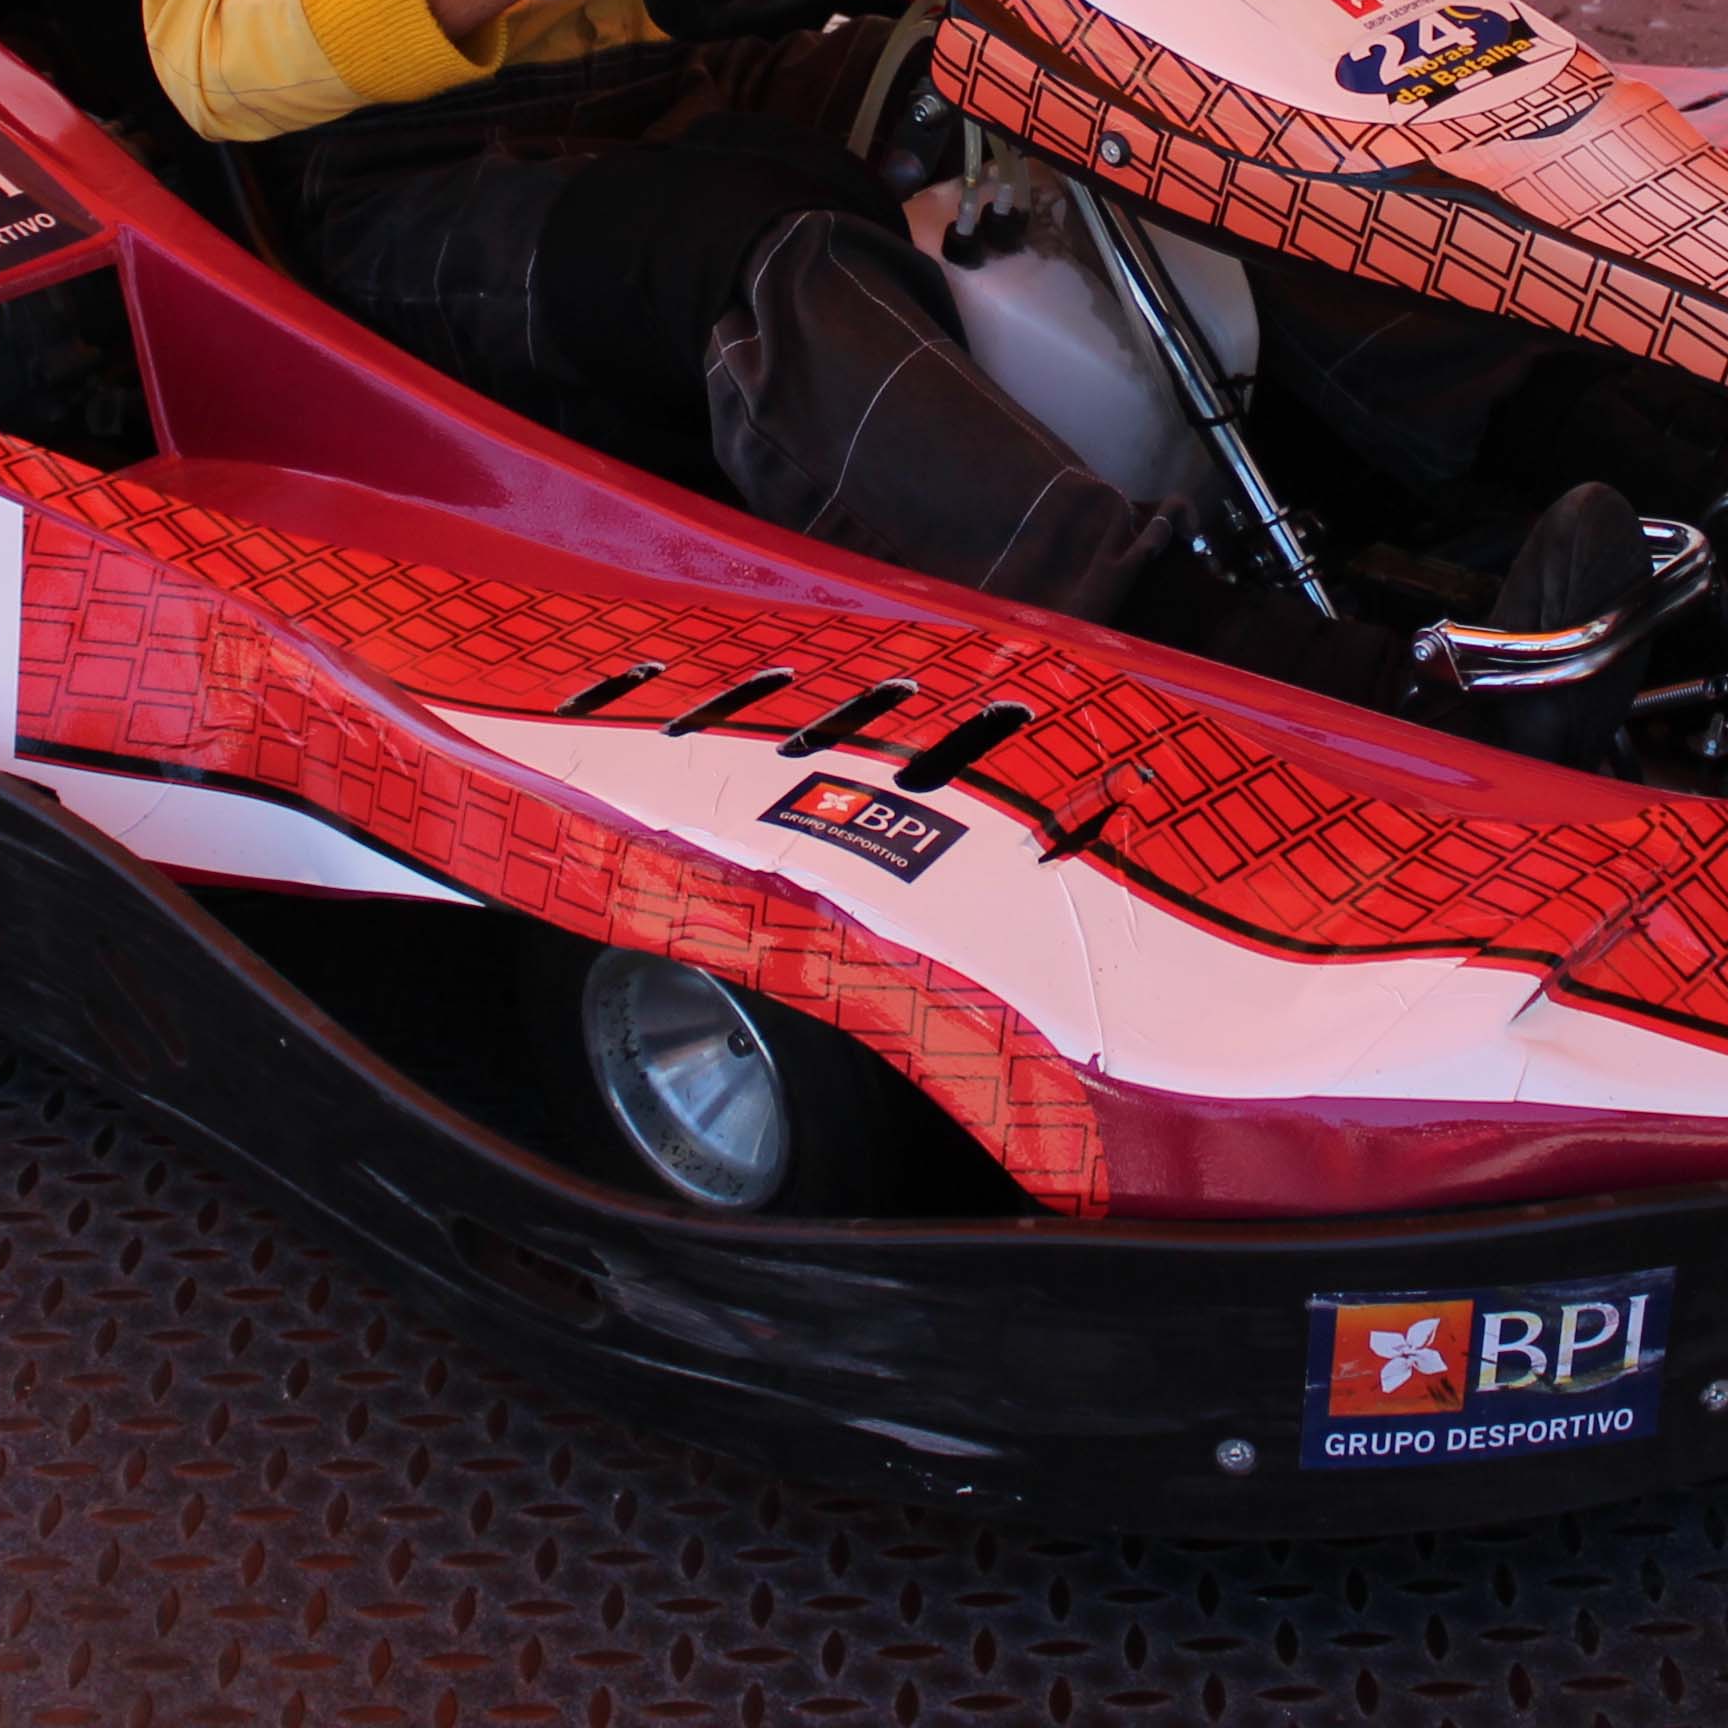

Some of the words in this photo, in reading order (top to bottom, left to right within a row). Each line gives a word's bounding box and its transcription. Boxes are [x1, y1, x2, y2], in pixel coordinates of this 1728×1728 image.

[1348, 10, 1479, 87] 24
[1395, 83, 1434, 105] da
[1430, 38, 1533, 87] Batalha
[1403, 44, 1475, 78] horas
[778, 810, 827, 831] GRUPO
[826, 824, 909, 869] DESPORTIVO
[852, 801, 942, 855] BPI
[1474, 1293, 1650, 1393] BPI
[1323, 1429, 1436, 1457] GRUPO
[1446, 1407, 1635, 1452] DESPORTIVO
